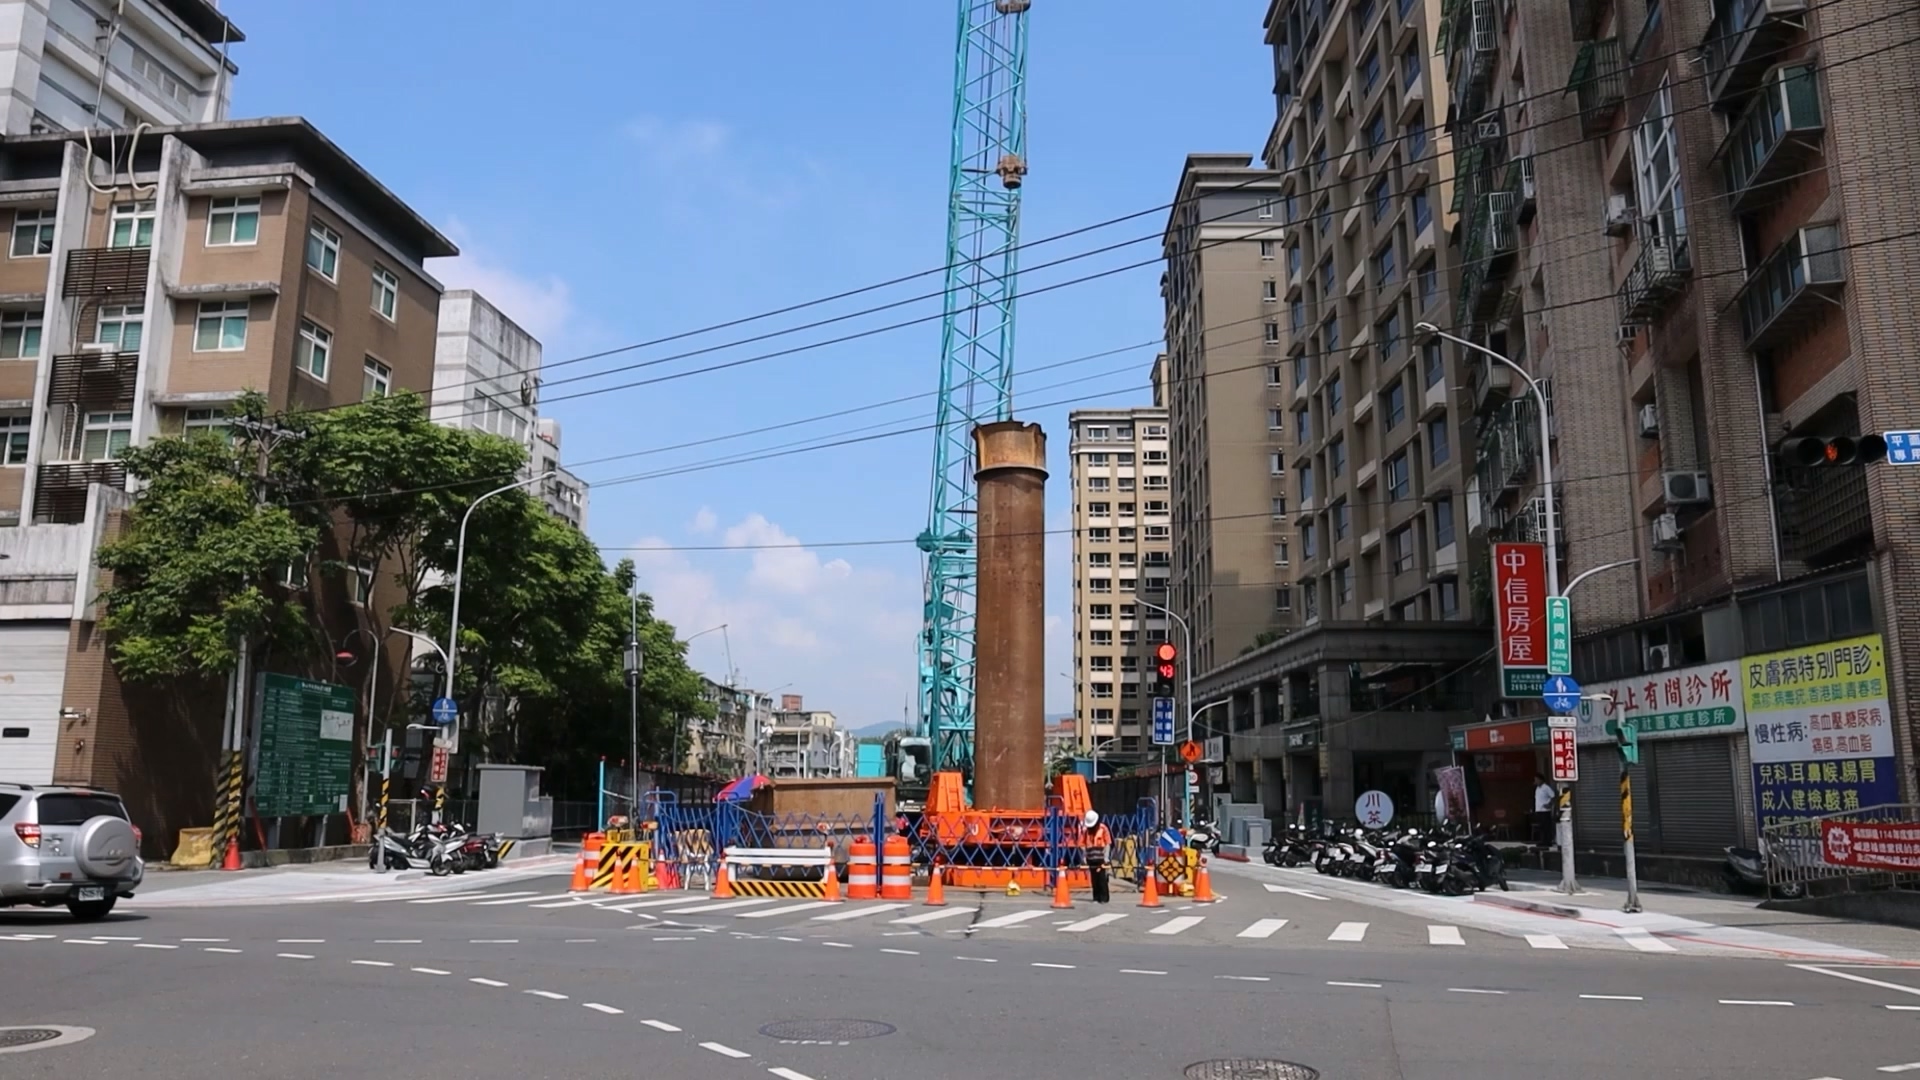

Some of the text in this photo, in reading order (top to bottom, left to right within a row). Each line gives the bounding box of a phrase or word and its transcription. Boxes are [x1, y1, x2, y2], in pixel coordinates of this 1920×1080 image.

[1502, 549, 1533, 661] 中信房屋
[1159, 665, 1174, 678] 43
[1365, 793, 1382, 825] 川菜
